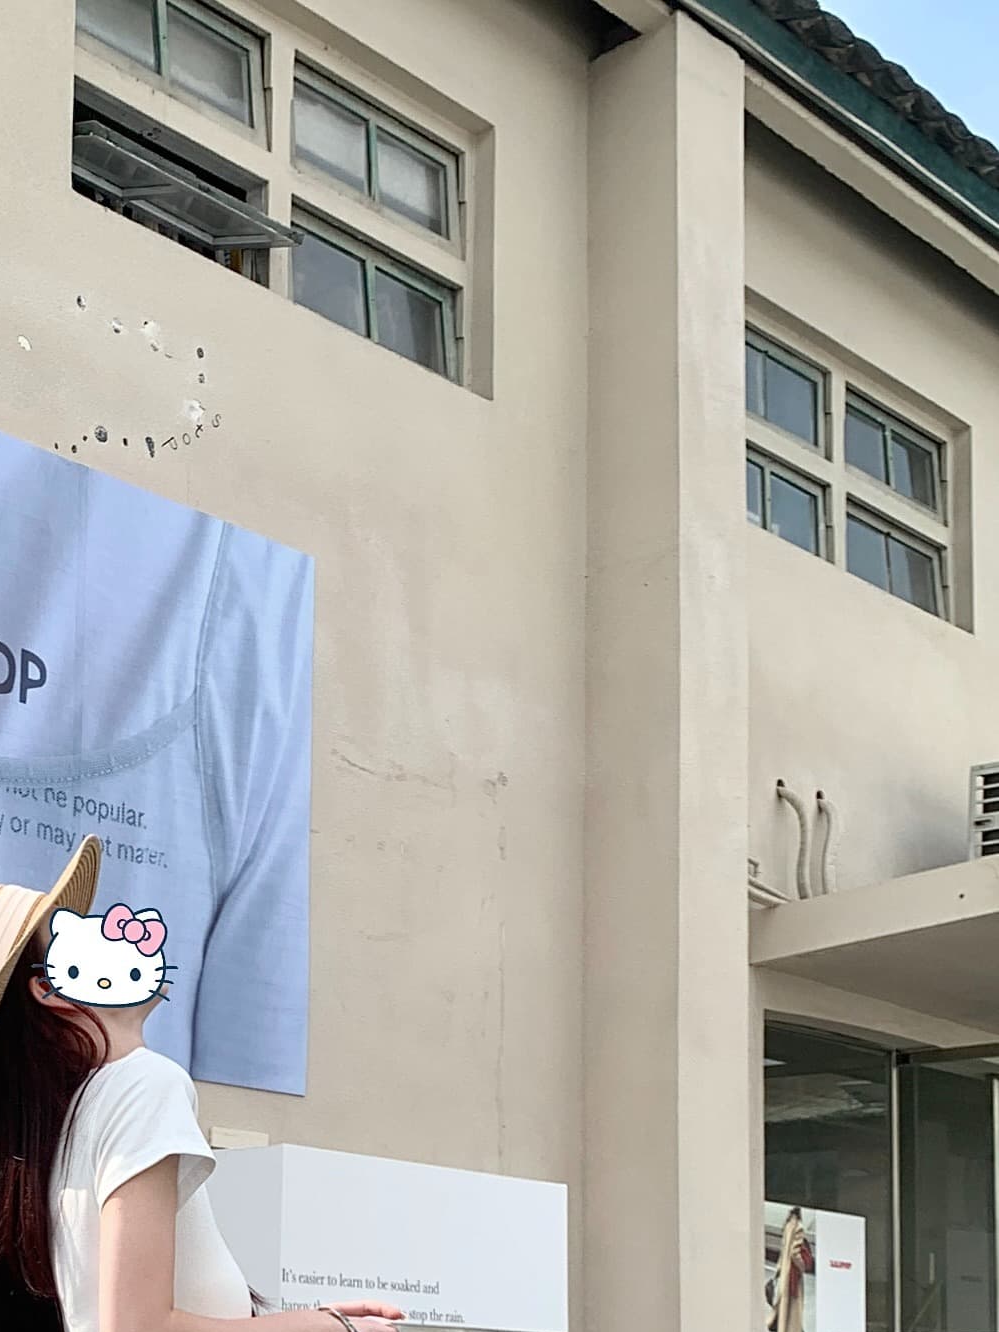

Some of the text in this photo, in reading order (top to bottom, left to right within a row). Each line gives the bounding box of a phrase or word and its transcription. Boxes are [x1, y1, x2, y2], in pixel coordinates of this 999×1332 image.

[73, 795, 147, 829] popular.
[10, 815, 30, 835] or
[37, 821, 76, 852] may
[282, 1267, 440, 1295] It's easier to learn to be soaked and
[409, 1309, 428, 1324] stop
[429, 1308, 444, 1321] the
